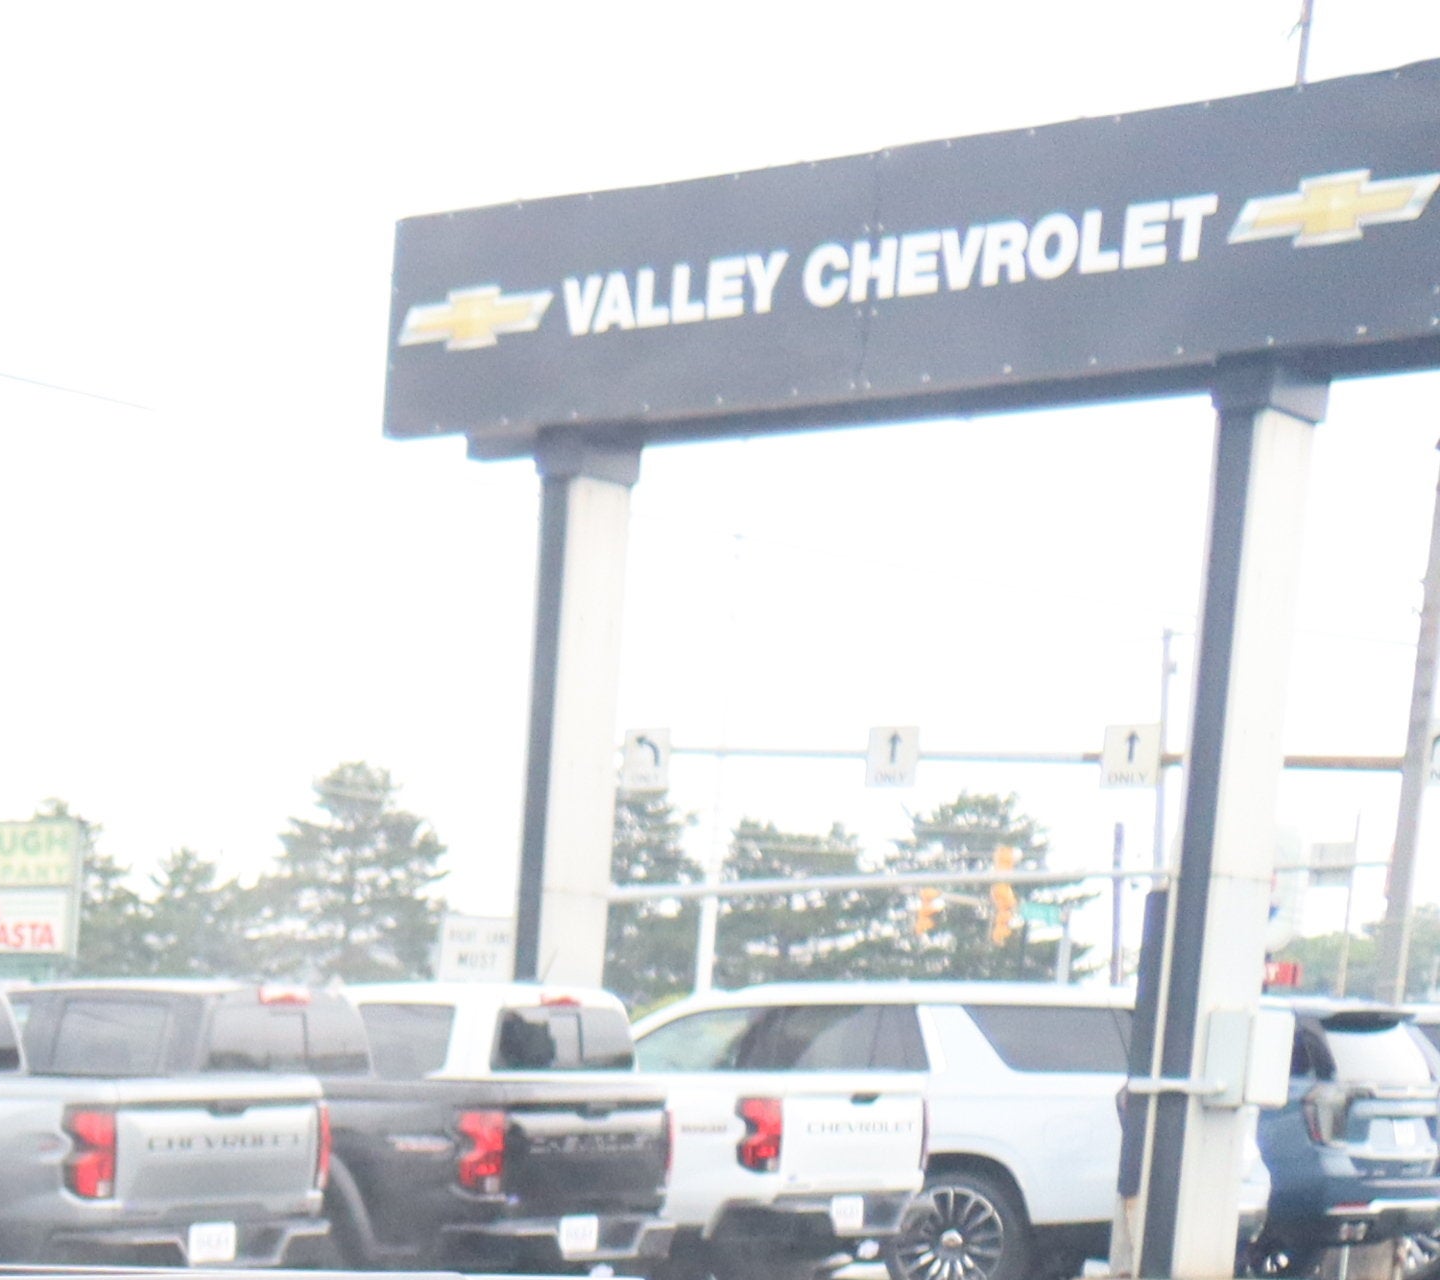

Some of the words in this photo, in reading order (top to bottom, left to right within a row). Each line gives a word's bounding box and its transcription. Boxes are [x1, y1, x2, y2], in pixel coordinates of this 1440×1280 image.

[563, 251, 788, 336] VALLEY
[803, 193, 1219, 309] CHEVROLET
[1107, 770, 1149, 784] ONLY
